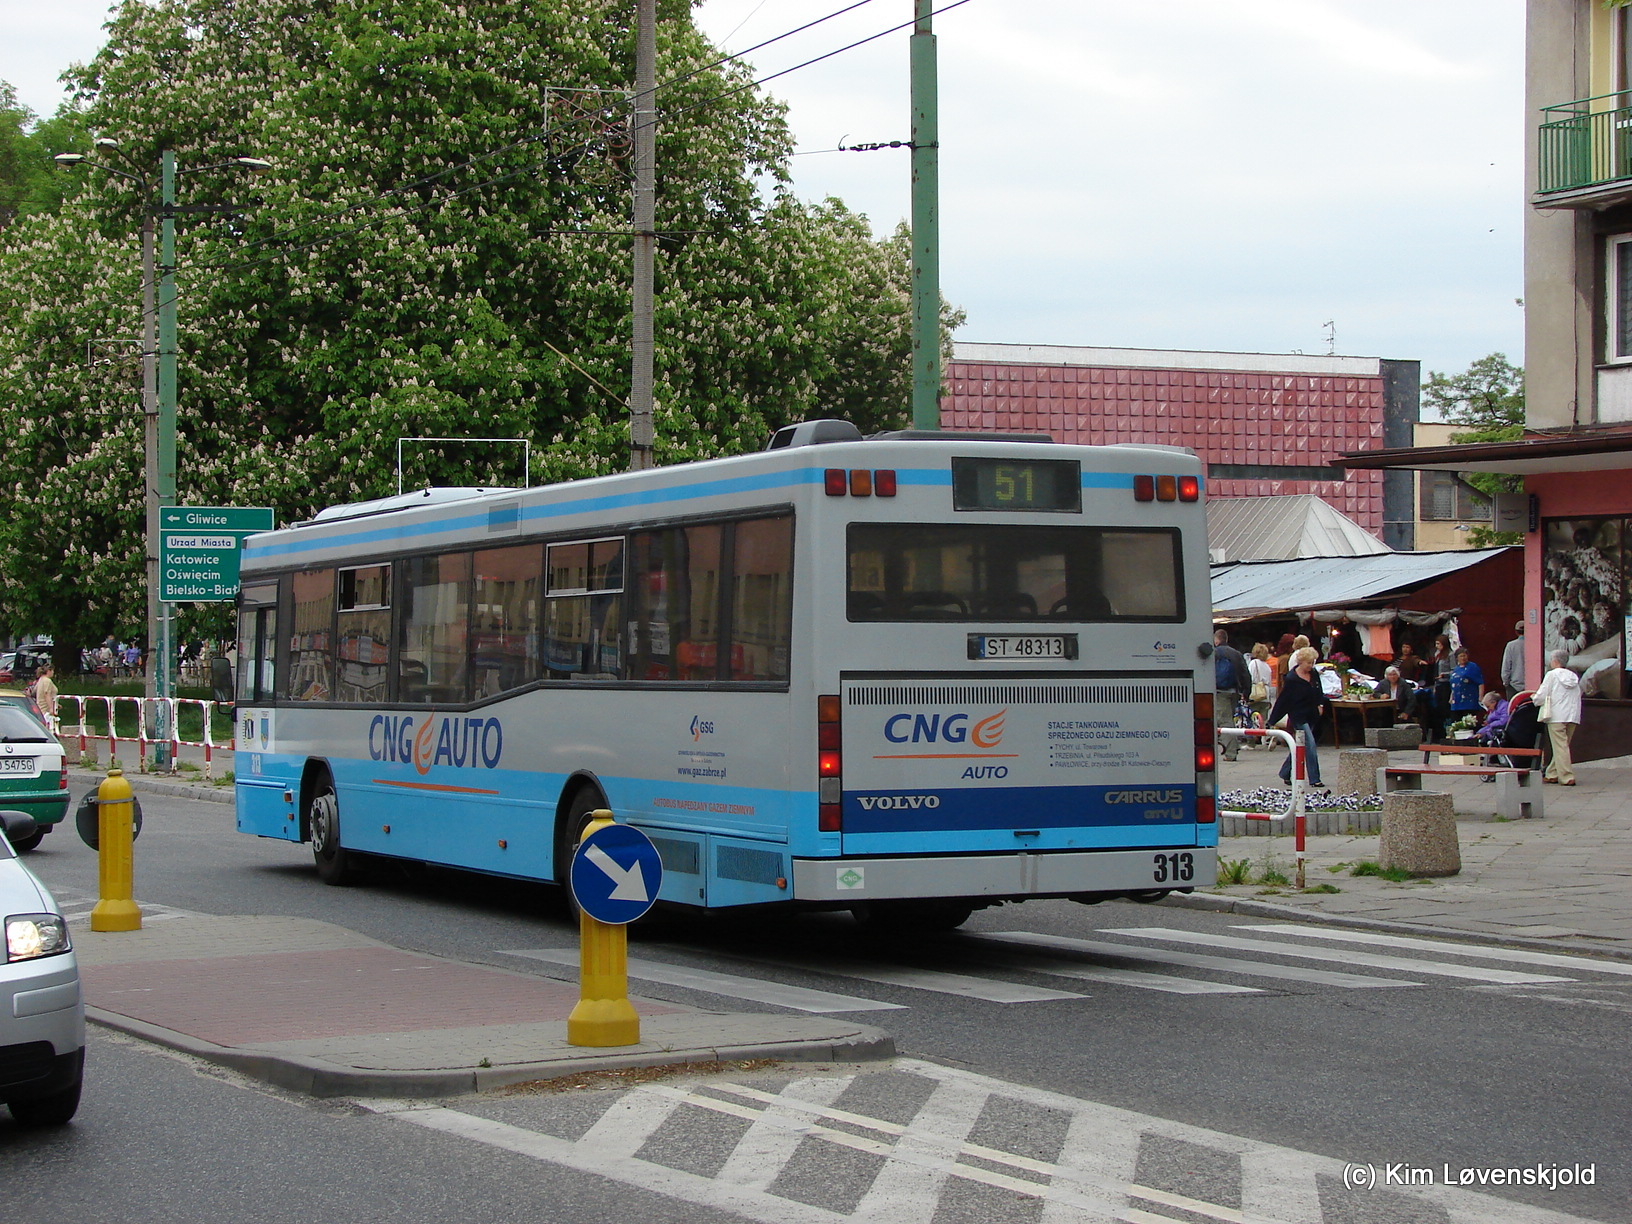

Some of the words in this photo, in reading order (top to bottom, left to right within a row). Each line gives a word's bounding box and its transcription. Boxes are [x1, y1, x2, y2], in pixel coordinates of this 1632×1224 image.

[995, 466, 1033, 501] 51
[186, 513, 228, 525] Gliwice
[170, 538, 196, 548] Urząd
[201, 538, 232, 547] Miasta
[166, 554, 220, 565] Katowice
[166, 568, 221, 582] Oświęcim
[166, 584, 239, 595] Bielsko-Biał
[987, 639, 1009, 655] ST
[1015, 639, 1062, 655] 48313
[700, 721, 714, 734] GSG
[884, 713, 969, 743] CNG
[1047, 721, 1073, 729] STACJE
[1075, 721, 1120, 729] TANKOWANIA
[369, 714, 414, 764] CNG
[433, 717, 503, 769] AUTO
[1047, 730, 1094, 741] SPRĘŻONEGO
[1095, 731, 1114, 739] GAZU
[1115, 730, 1152, 739] ZIEMNEGO
[1151, 730, 1170, 740] (CNG)
[4, 760, 33, 770] 5475G
[677, 766, 727, 779] www.gaz.zabrze.pl
[961, 766, 1009, 779] AUTO
[653, 797, 676, 808] AUTOBUS
[857, 795, 940, 810] VOLVO
[1104, 789, 1183, 804] CARRUS
[1153, 852, 1194, 883] 313
